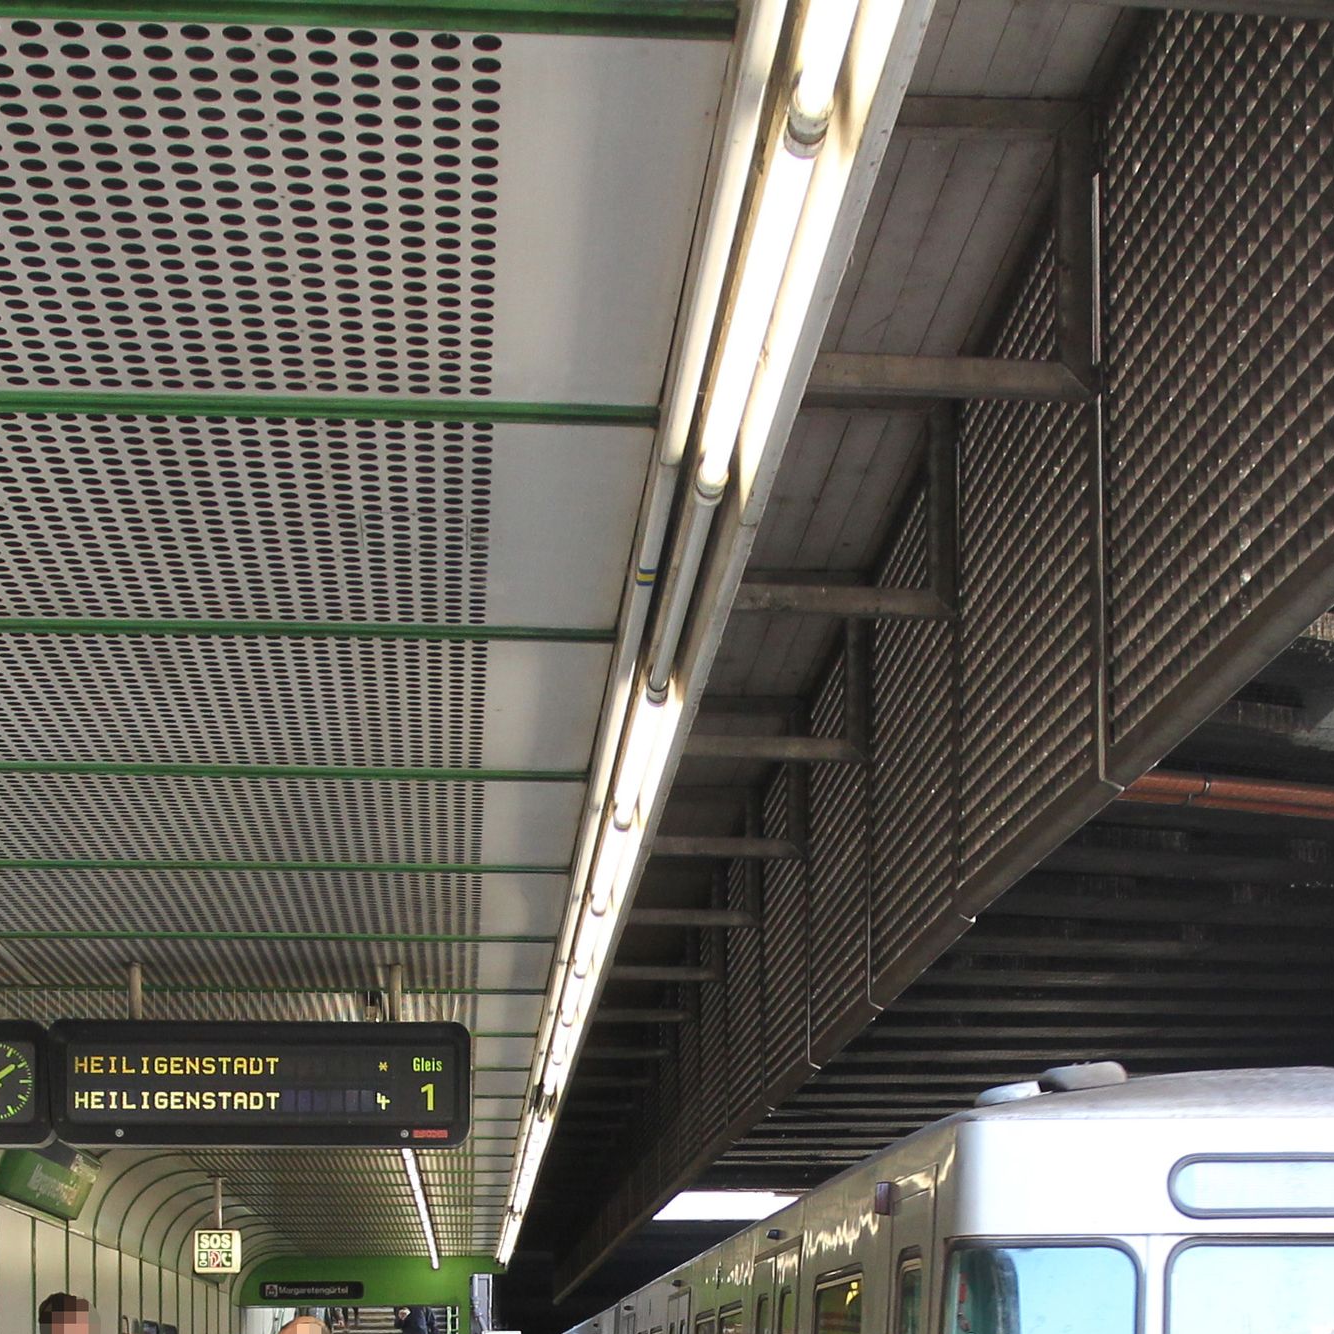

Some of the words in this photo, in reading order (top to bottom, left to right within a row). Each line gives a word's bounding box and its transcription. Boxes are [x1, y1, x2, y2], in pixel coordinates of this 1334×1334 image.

[74, 1056, 279, 1075] HEILIGENSTADT
[412, 1057, 443, 1072] Gleis
[74, 1091, 280, 1110] HEILIGENSTADT
[376, 1092, 390, 1110] 4
[420, 1083, 434, 1111] 1
[199, 1233, 231, 1249] SOS
